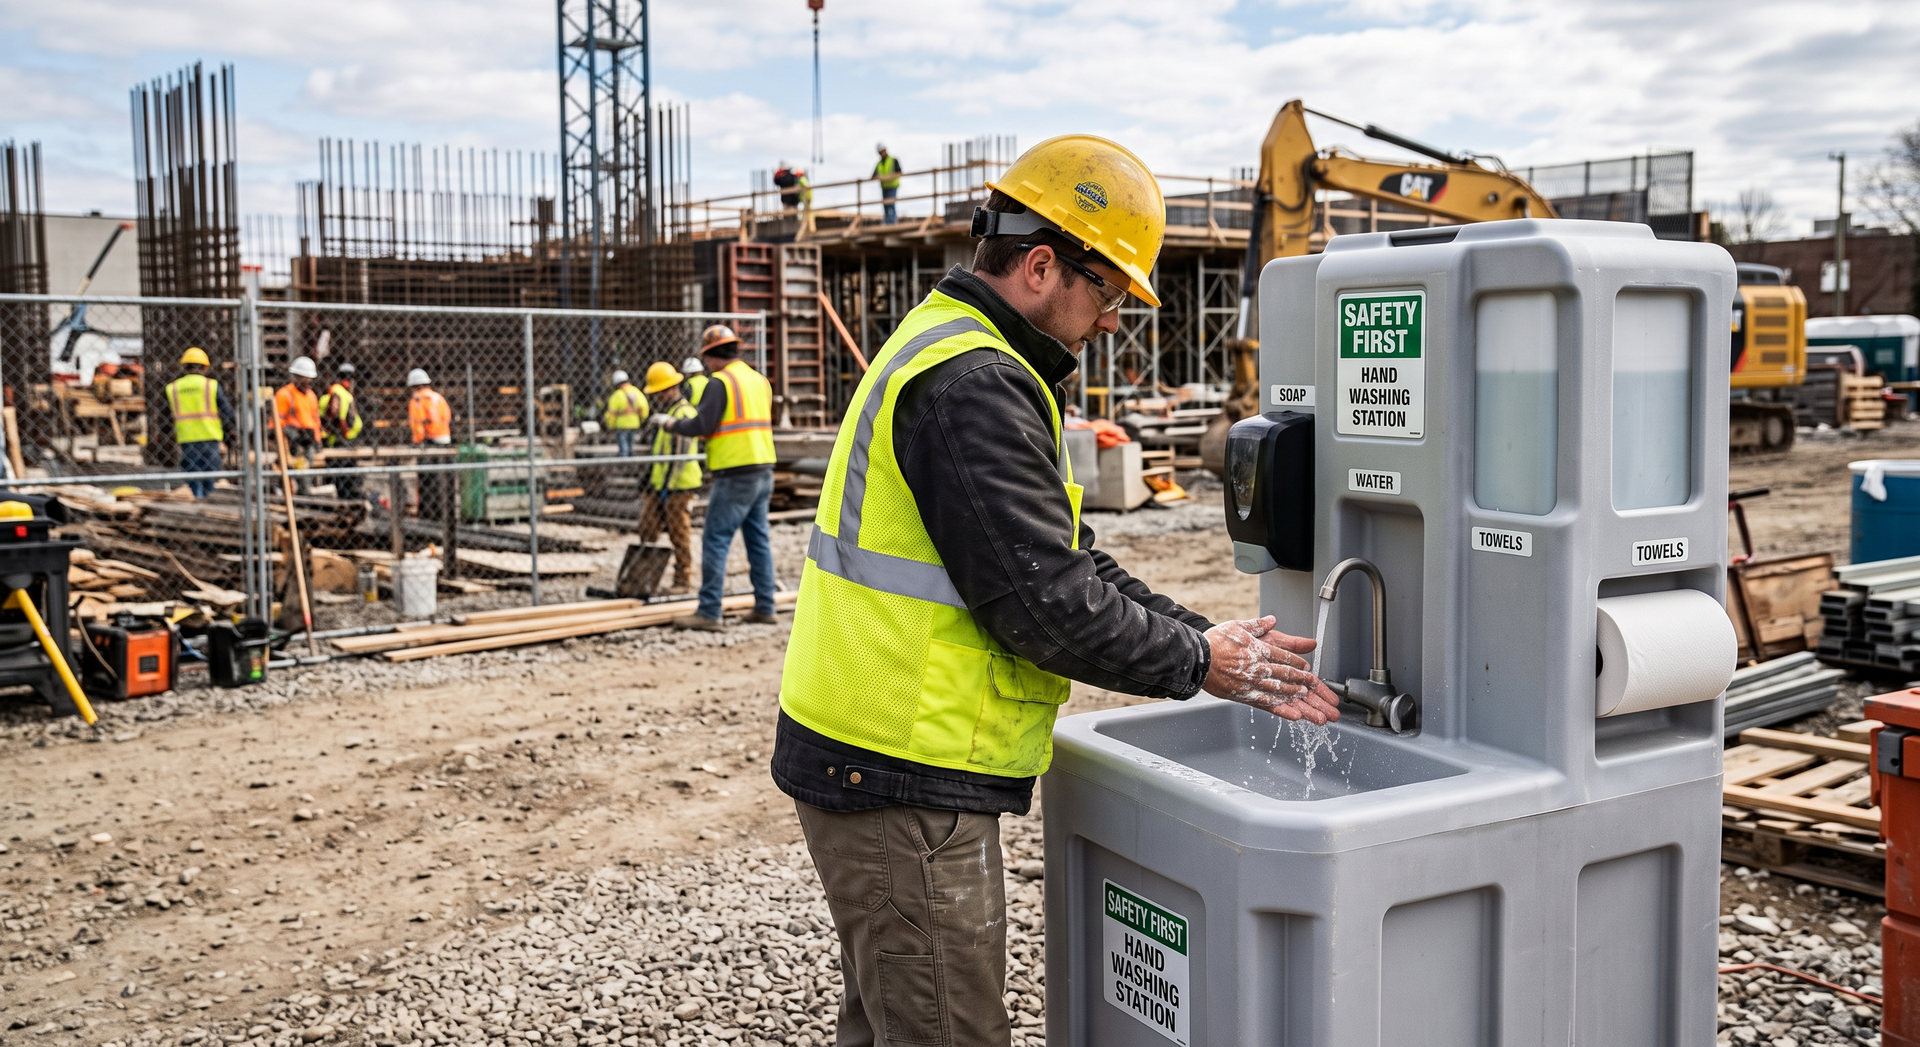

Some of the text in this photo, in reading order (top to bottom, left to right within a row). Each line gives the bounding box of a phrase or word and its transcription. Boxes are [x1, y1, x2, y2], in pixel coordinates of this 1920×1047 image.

[1400, 173, 1433, 202] CAT
[1344, 301, 1417, 326] SAFETY
[1353, 329, 1408, 353] FIRST
[1361, 367, 1398, 383] HAND
[1279, 388, 1306, 402] SOAP
[1349, 388, 1410, 406] WASHING
[1352, 410, 1406, 427] STATION
[1355, 473, 1394, 490] WATER
[1479, 531, 1523, 551] TOWELS
[1637, 542, 1684, 562] TOWELS
[1108, 889, 1183, 947] SAFETY FIRST
[1124, 932, 1165, 972] HAND
[1111, 951, 1180, 1009] WASHING
[1115, 980, 1176, 1033] STATION
